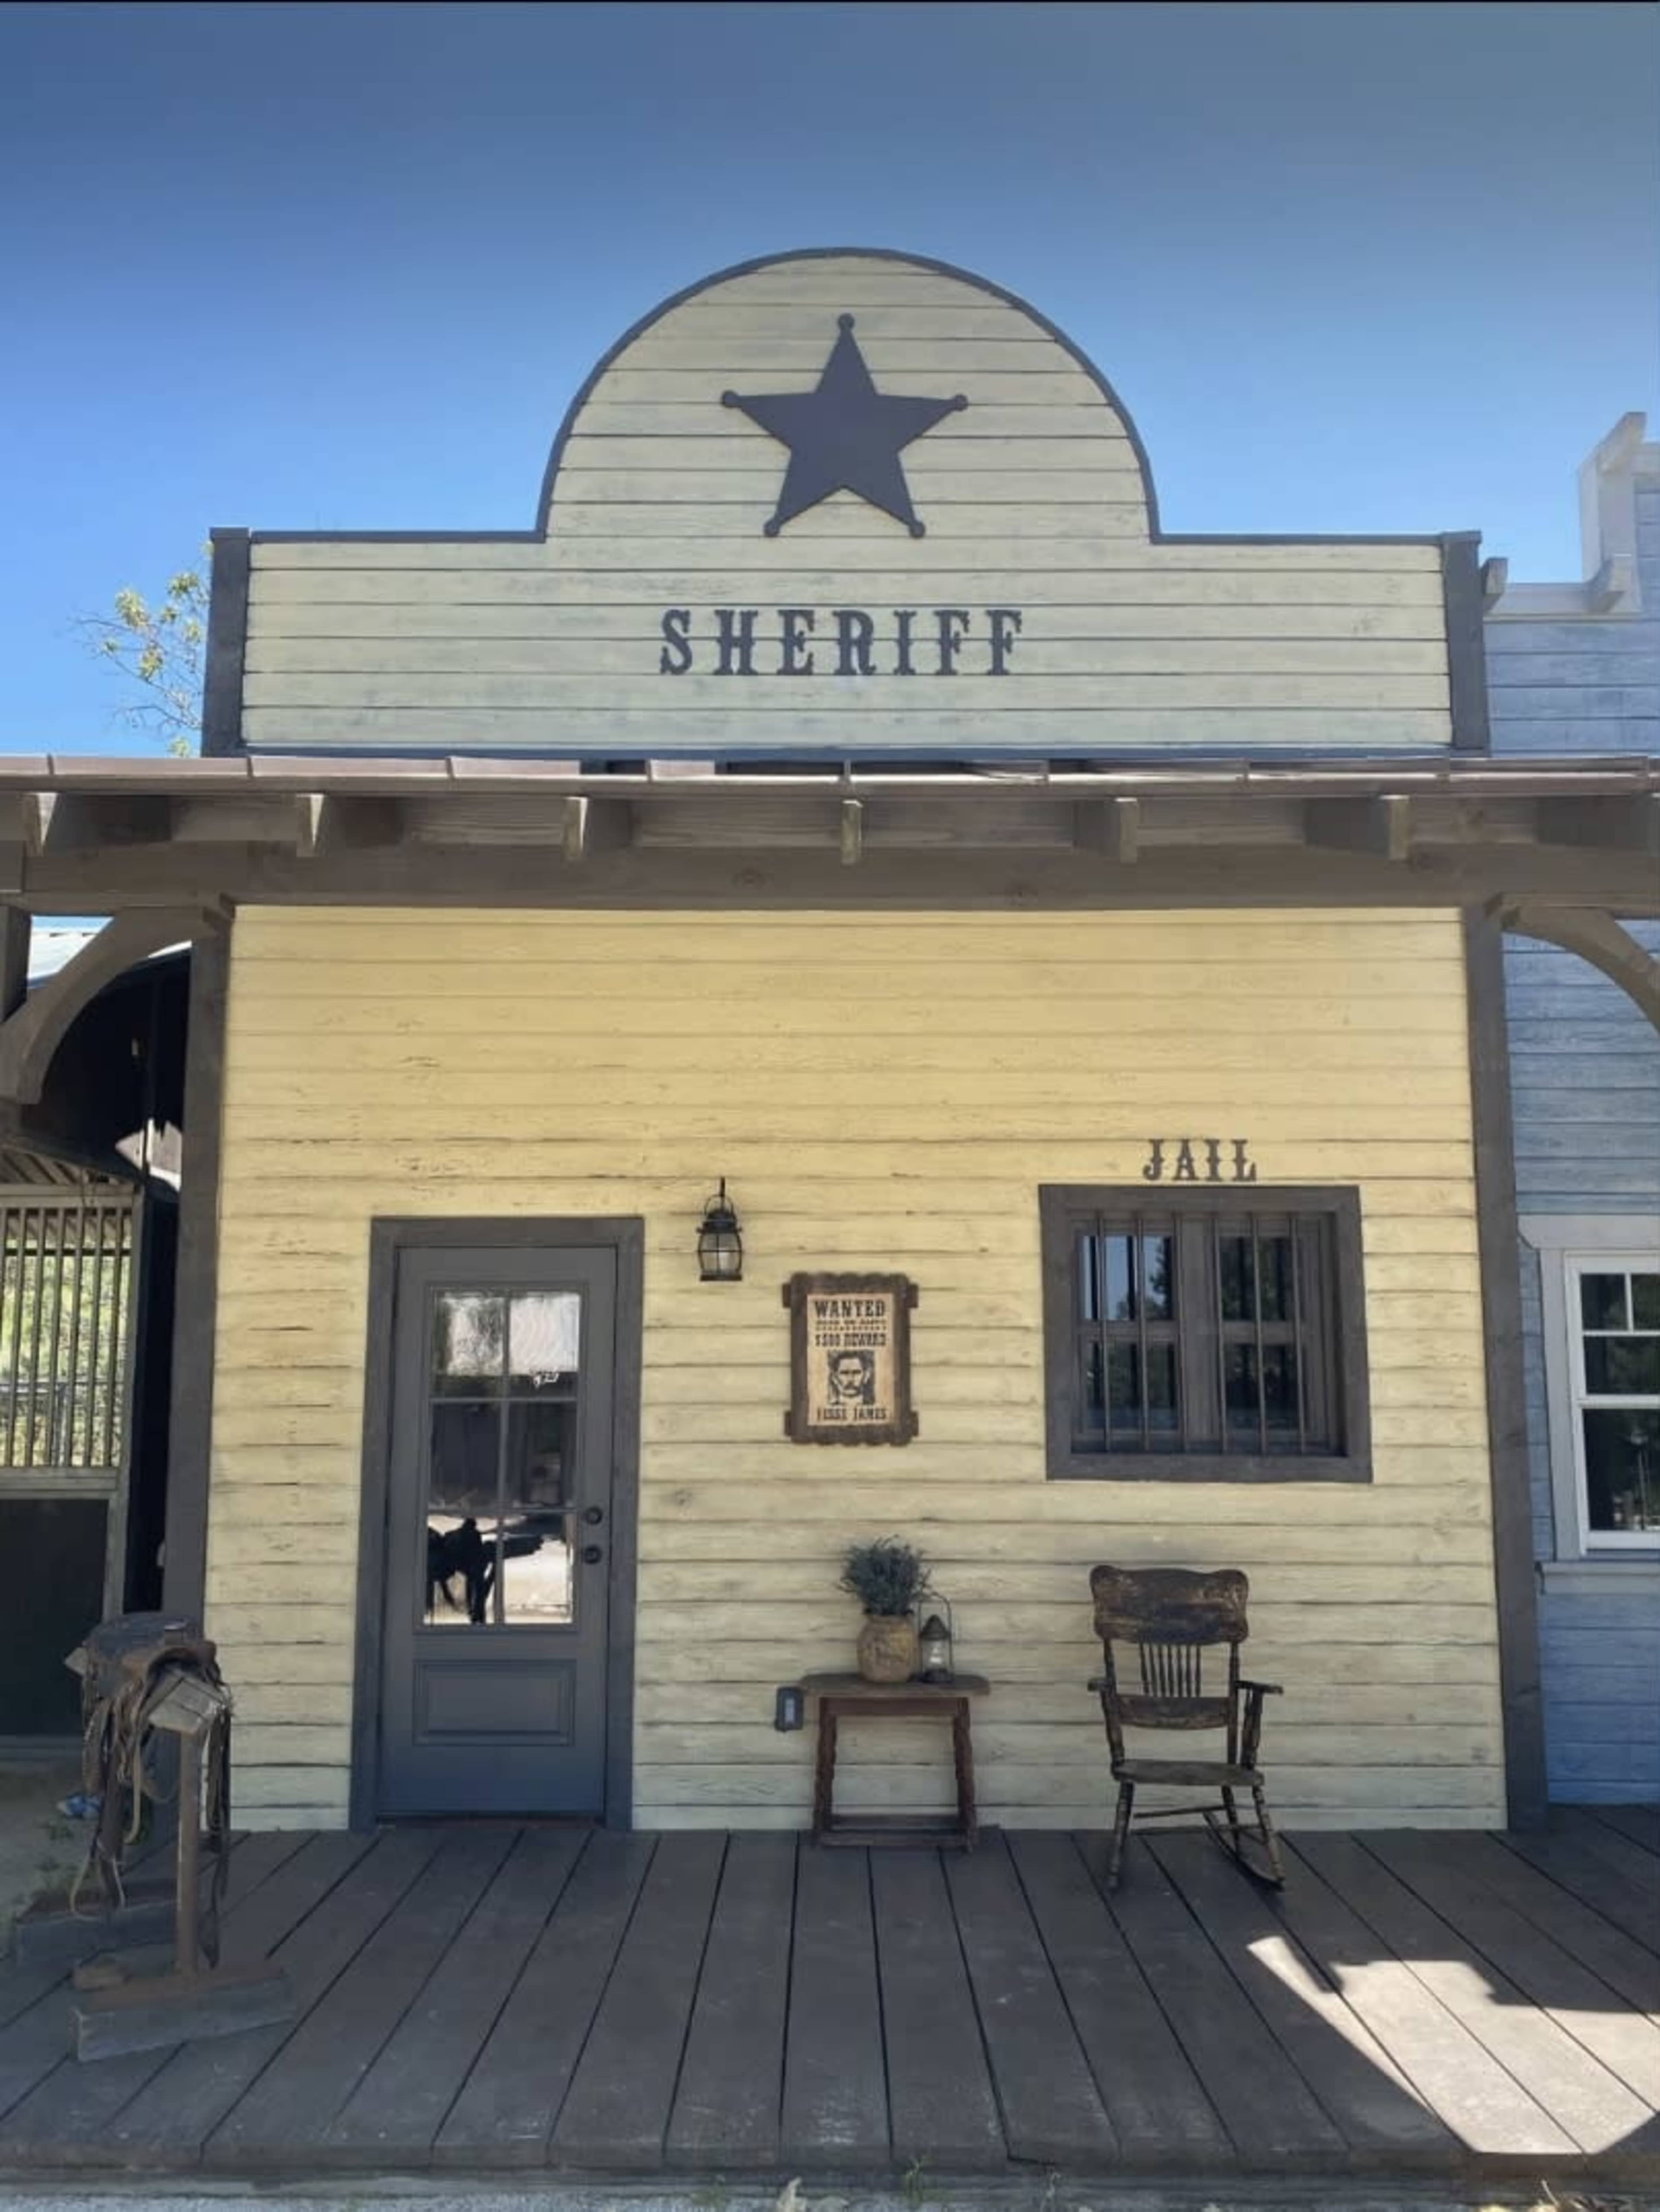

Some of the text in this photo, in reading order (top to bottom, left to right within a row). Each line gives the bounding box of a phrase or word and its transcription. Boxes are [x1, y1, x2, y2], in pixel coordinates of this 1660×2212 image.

[660, 609, 1022, 676] SHERIFF
[1143, 1138, 1256, 1181] JAIL
[815, 1300, 886, 1317] WANTED
